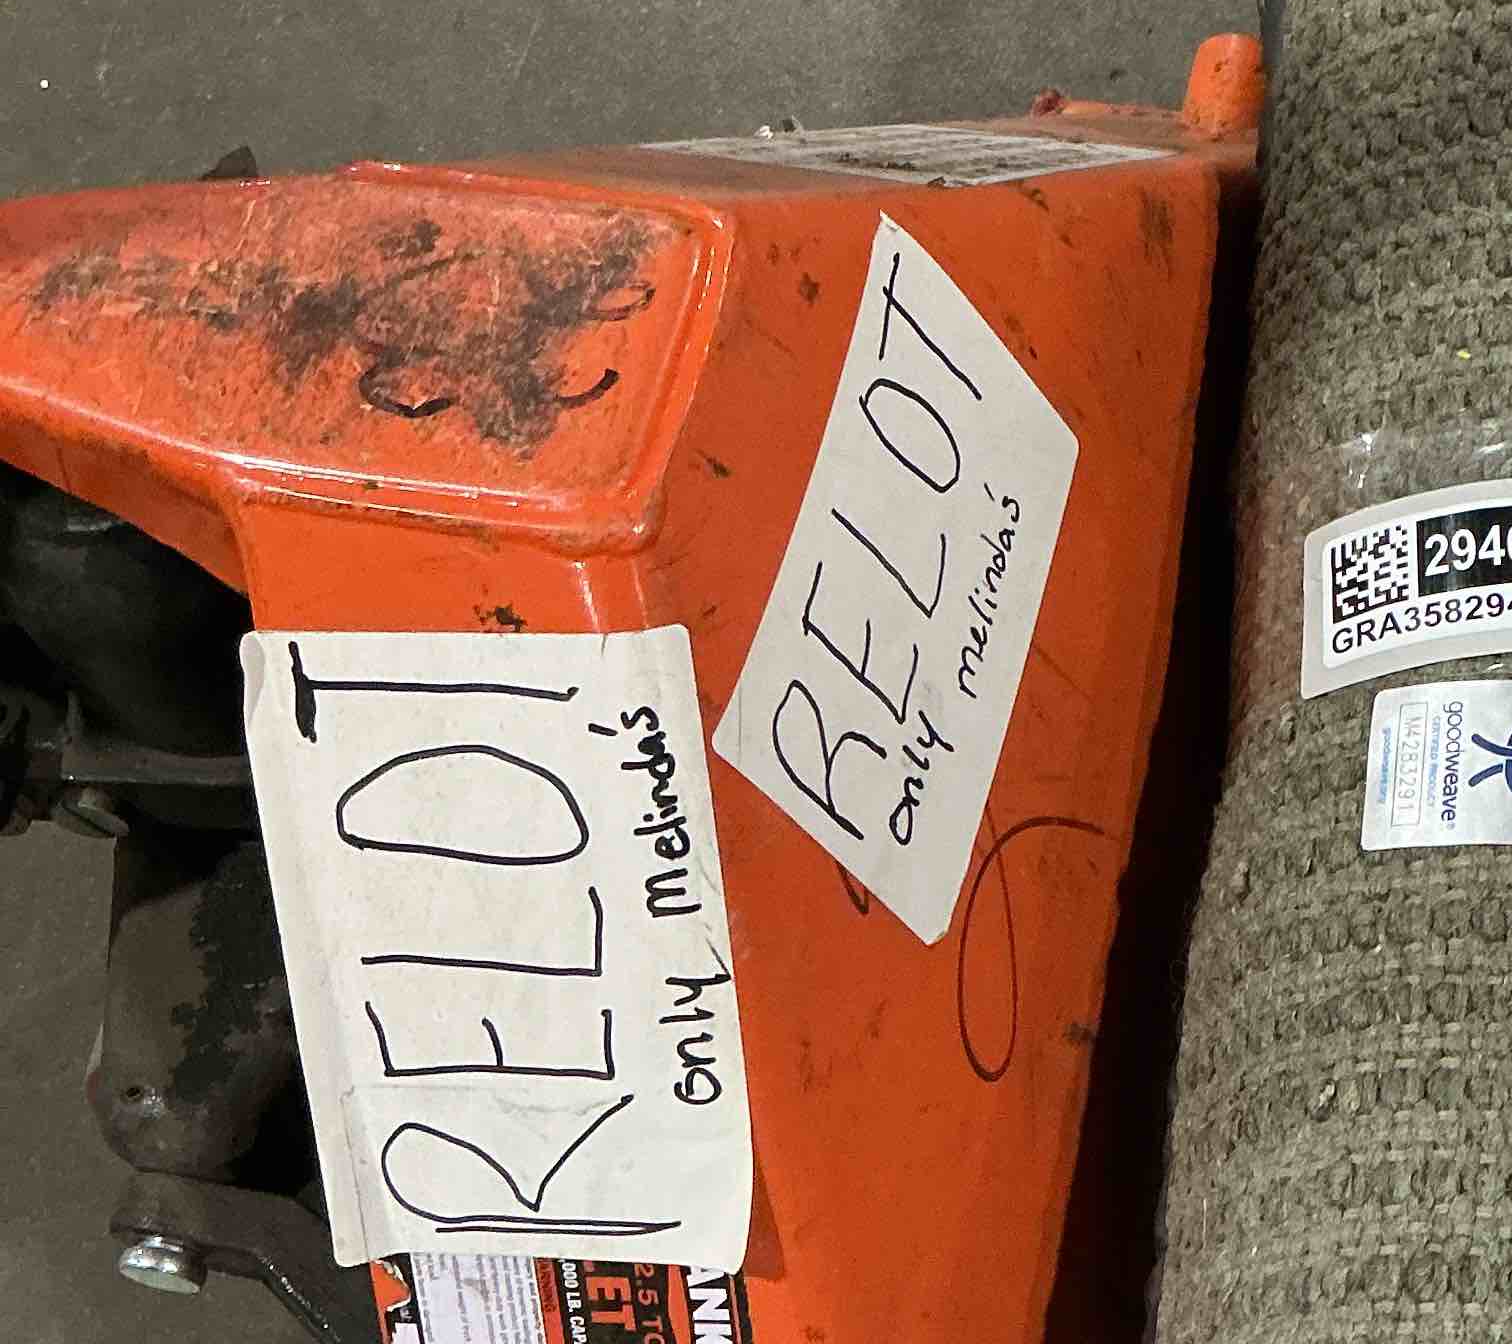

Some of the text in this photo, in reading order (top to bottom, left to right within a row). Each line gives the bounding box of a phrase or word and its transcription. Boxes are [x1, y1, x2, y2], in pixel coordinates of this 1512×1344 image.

[772, 253, 982, 840] RELOT
[889, 709, 955, 846] only
[289, 640, 682, 1235] RELOT
[566, 1292, 582, 1313] LB.
[634, 1263, 660, 1305] 2.5
